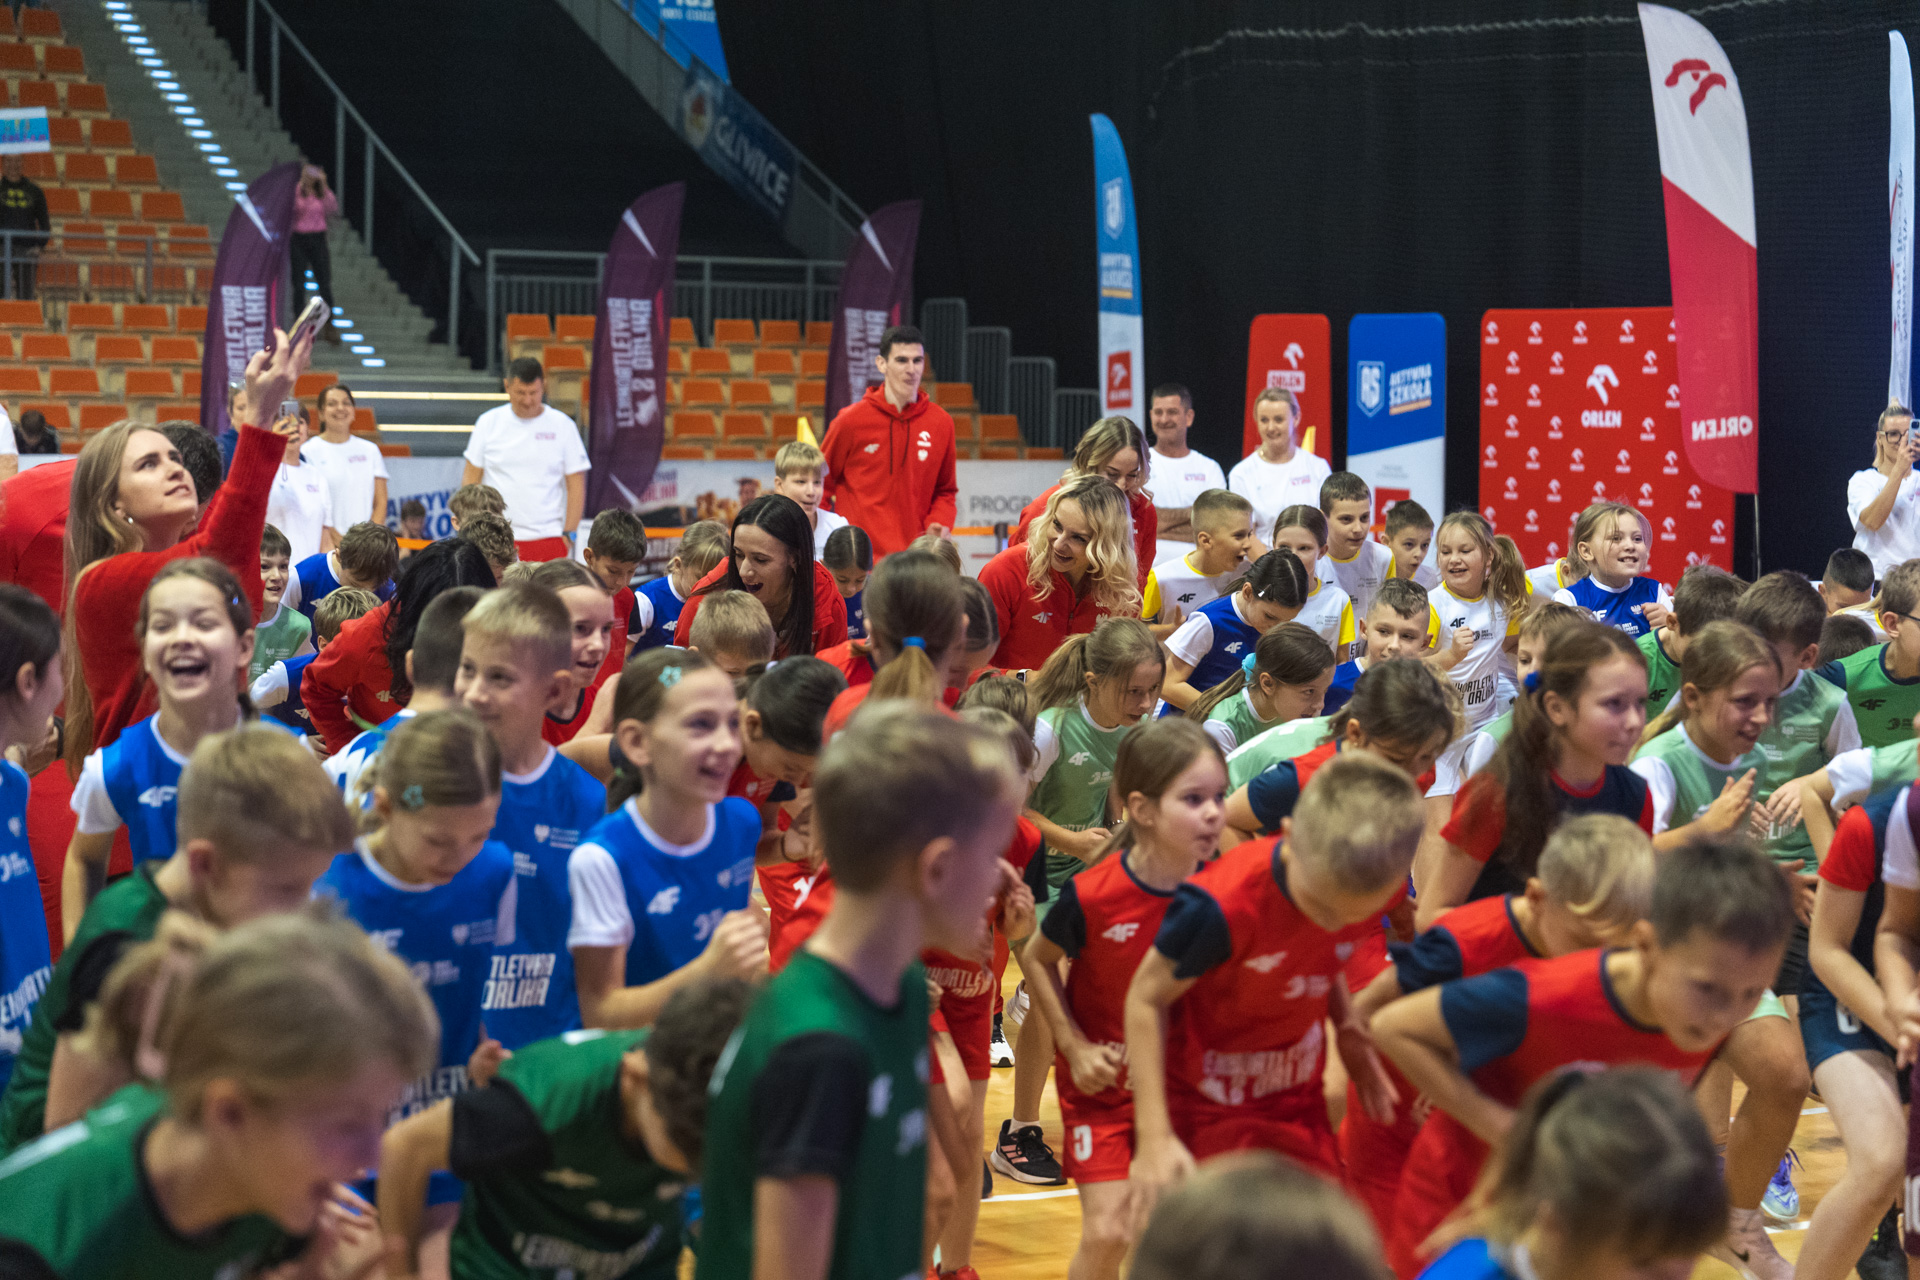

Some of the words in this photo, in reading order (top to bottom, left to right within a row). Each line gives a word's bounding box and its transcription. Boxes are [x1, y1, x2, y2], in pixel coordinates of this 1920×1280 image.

[1581, 410, 1622, 428] ORLEN
[969, 494, 1034, 514] PROGR
[1177, 593, 1196, 603] 4F
[1450, 617, 1466, 628] 4F
[1223, 641, 1243, 654] 4F
[1648, 688, 1668, 702] 4F
[1858, 698, 1887, 711] 4F
[1068, 751, 1091, 766] 4F
[1102, 922, 1140, 943] 4F
